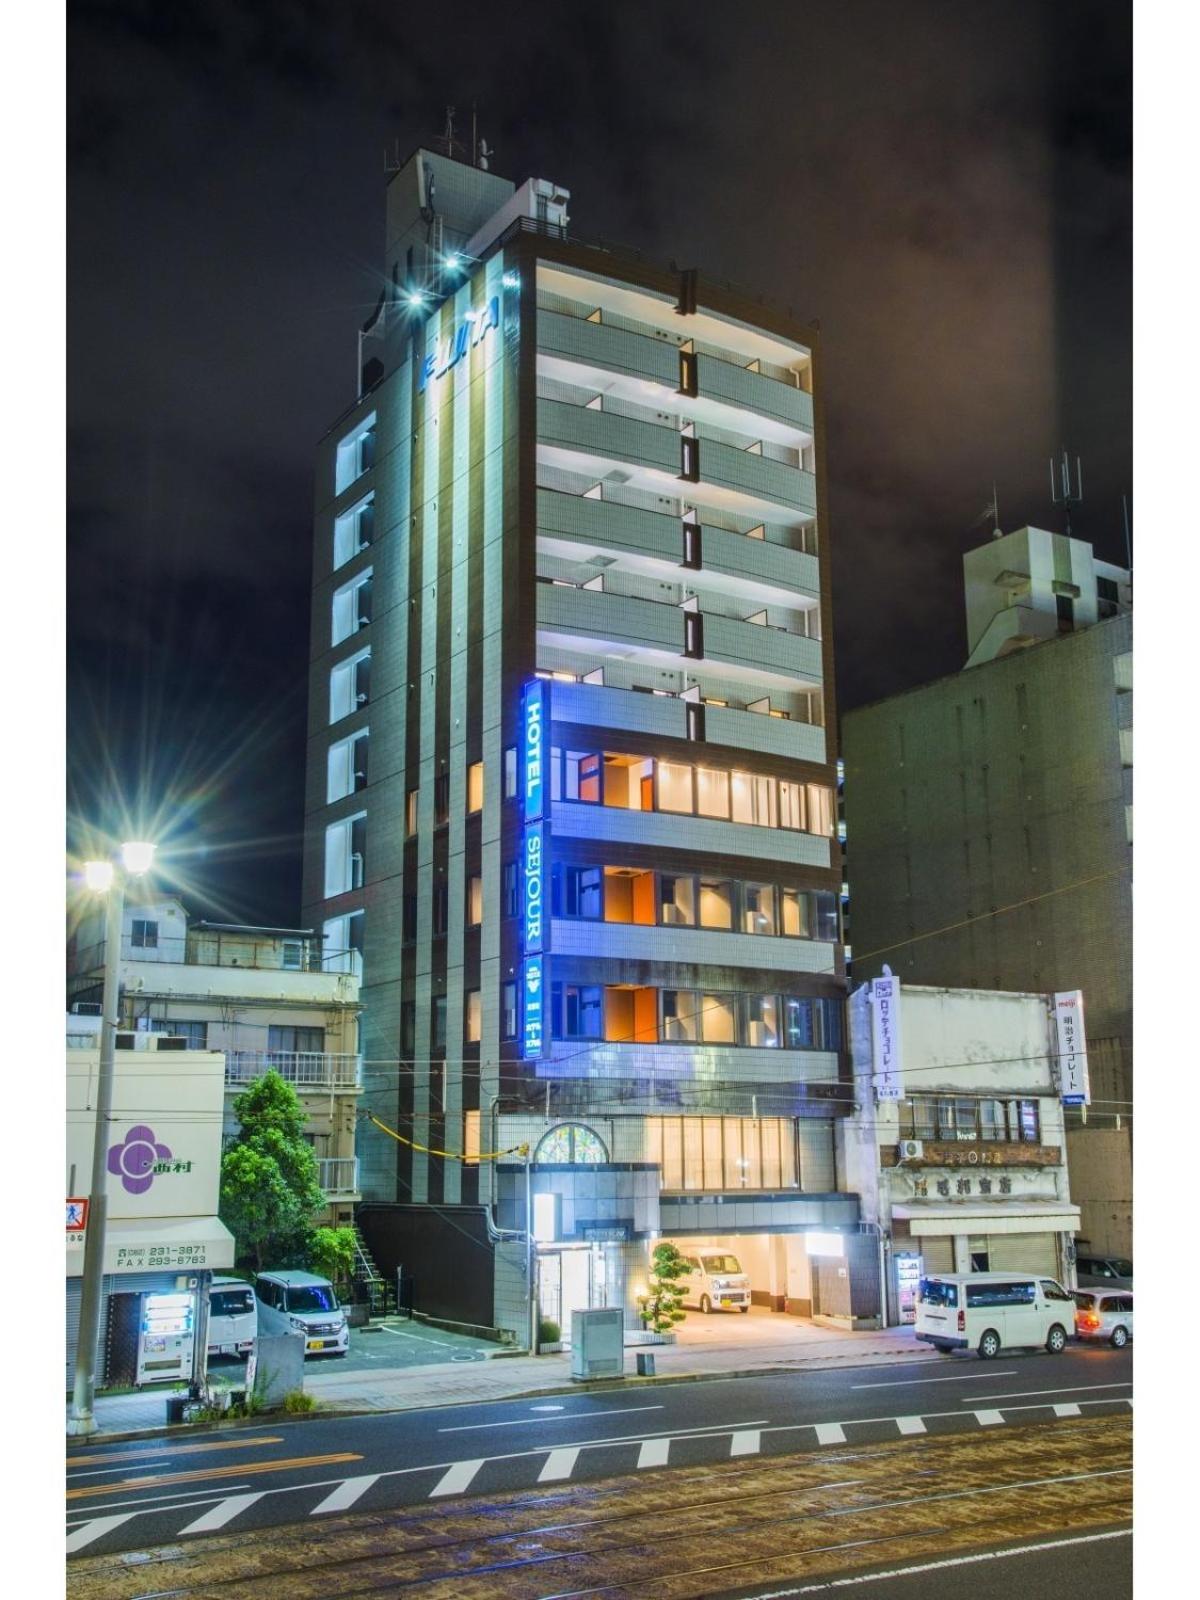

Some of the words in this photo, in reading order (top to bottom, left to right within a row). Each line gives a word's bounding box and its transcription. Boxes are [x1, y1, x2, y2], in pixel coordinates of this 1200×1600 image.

[527, 702, 541, 798] HOTEL
[525, 836, 541, 942] SEJOUR
[1058, 1000, 1076, 1008] meiji
[1063, 1016, 1078, 1091] 明治チョコレート
